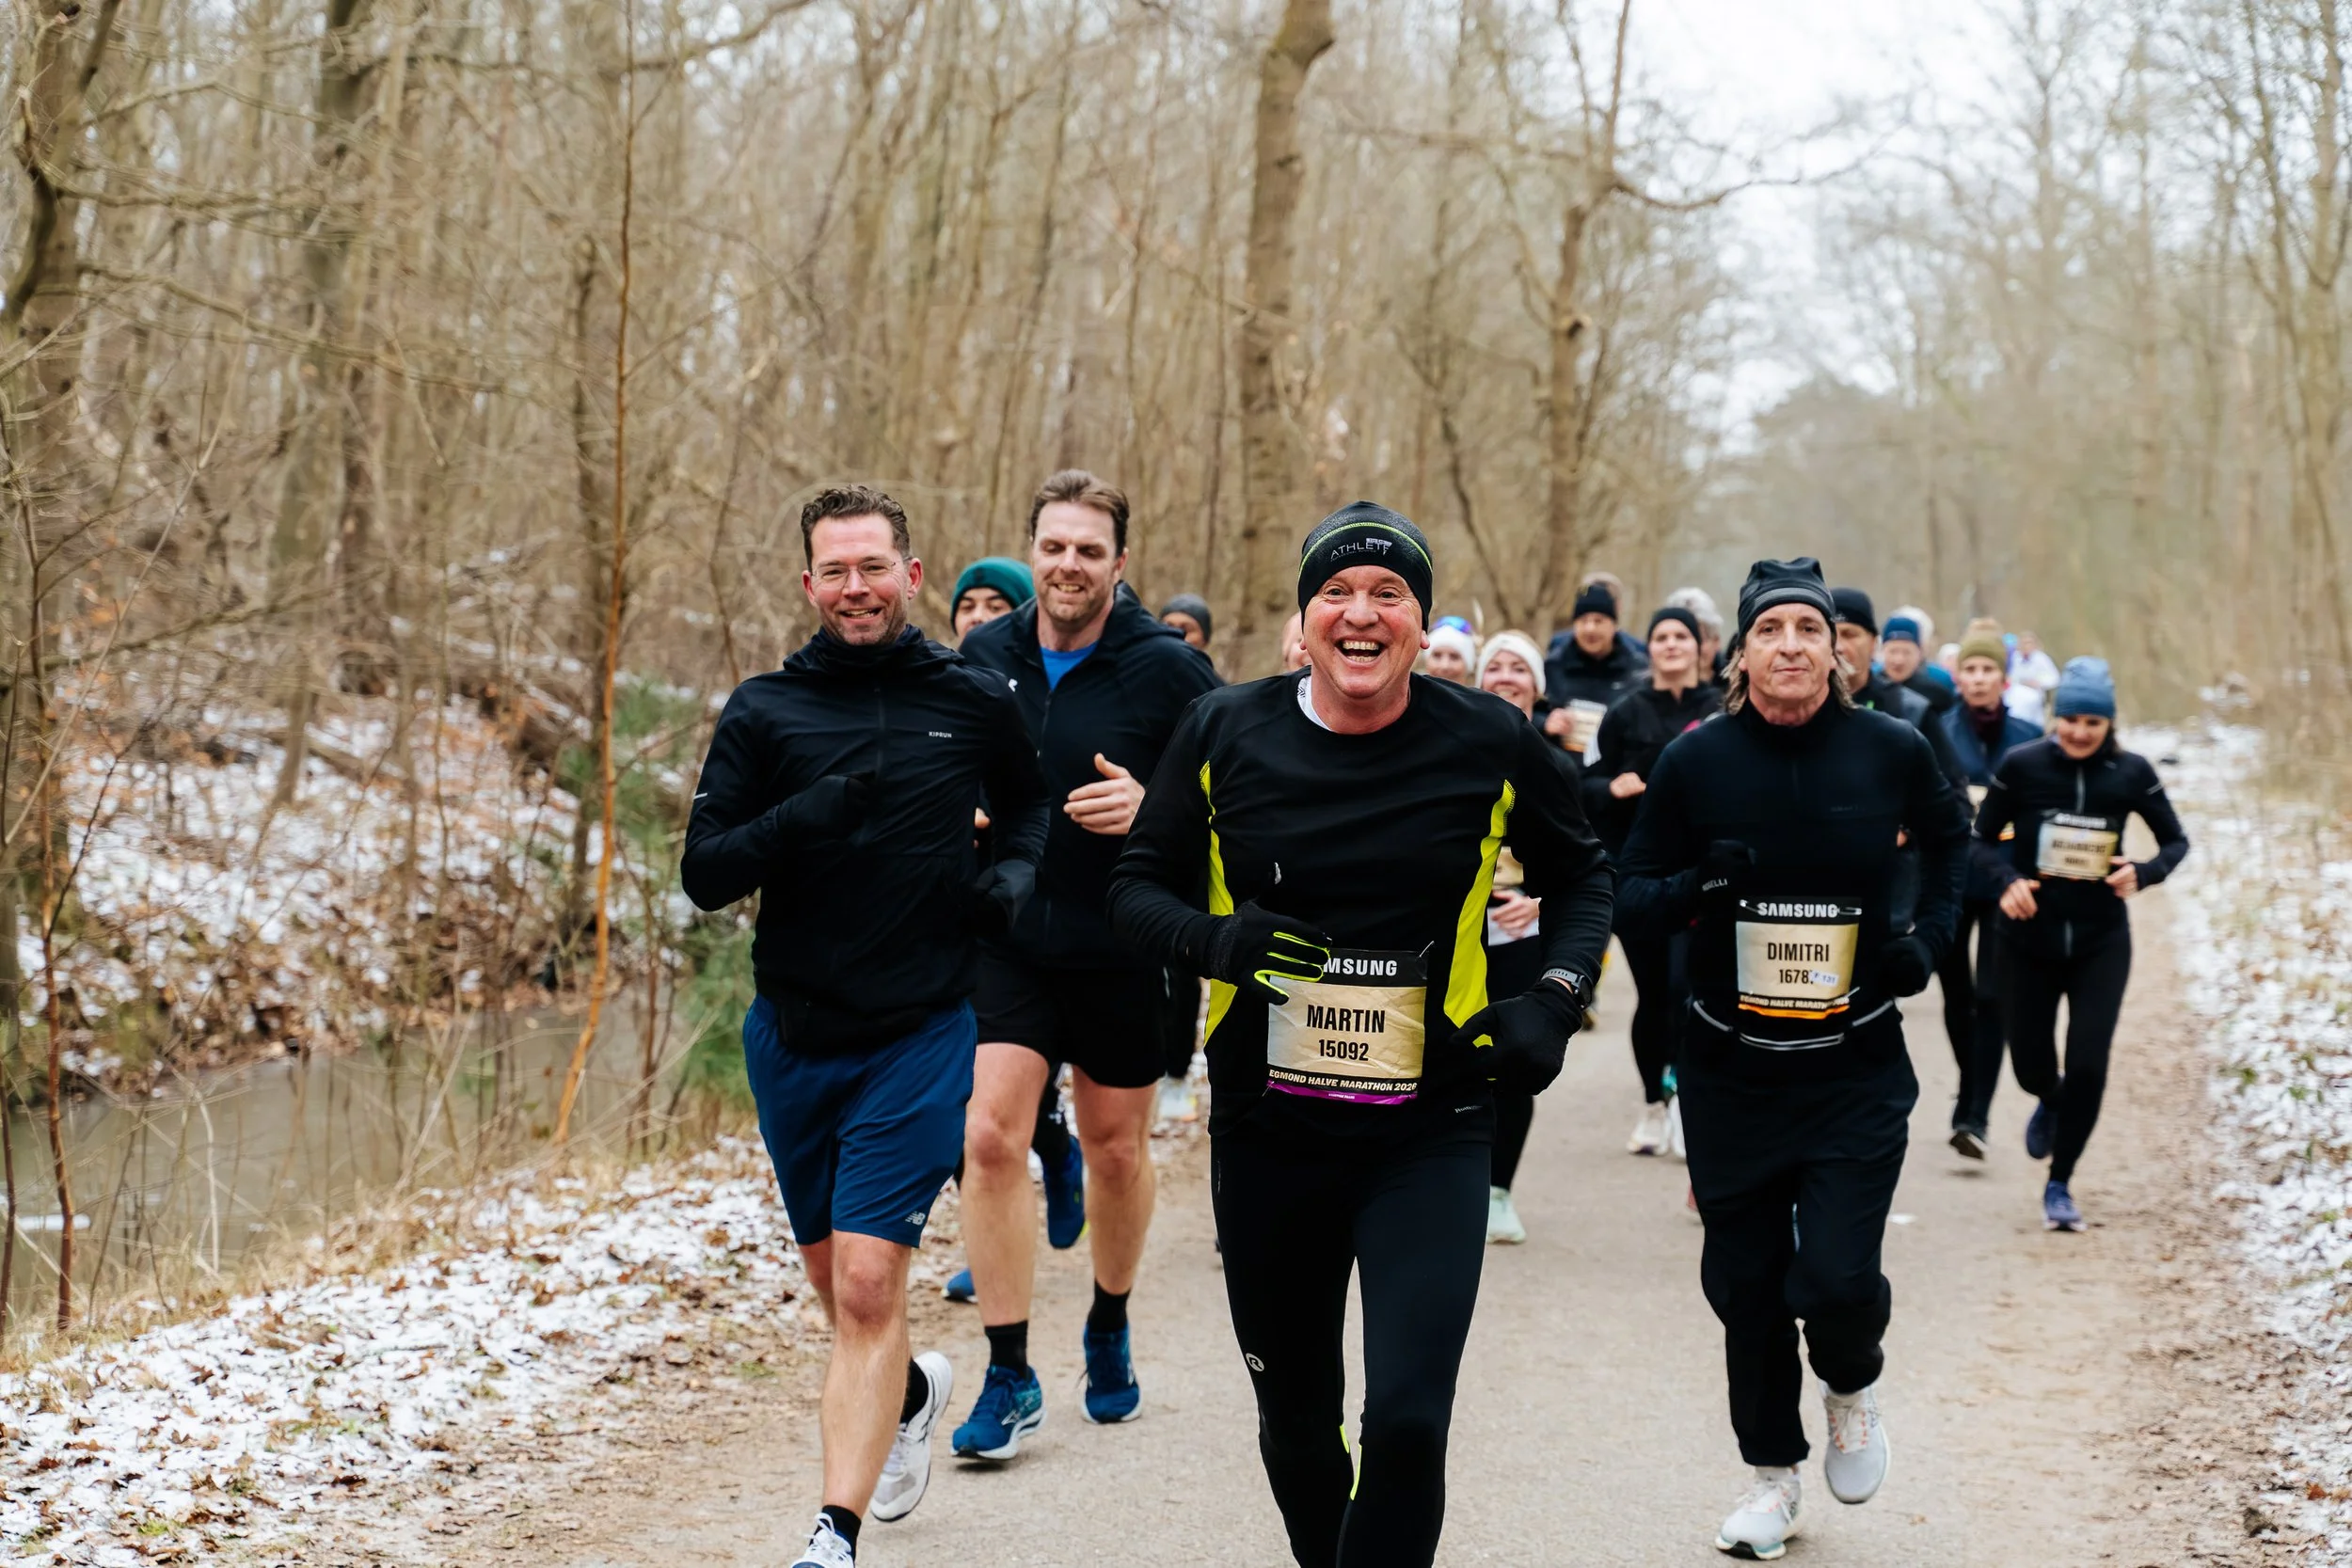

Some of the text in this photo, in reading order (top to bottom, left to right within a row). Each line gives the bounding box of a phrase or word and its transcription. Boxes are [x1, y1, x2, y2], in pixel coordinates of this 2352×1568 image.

[1756, 902, 1839, 918] SAMSUNG
[1768, 942, 1829, 962] DIMITRI
[1323, 958, 1397, 976] MSUNG
[1779, 969, 1814, 985] 1678
[1306, 1004, 1386, 1034] MARTIN
[1318, 1038, 1369, 1062] 15092
[1268, 1069, 1418, 1092] EGMOND HALVE MARATHON 2026
